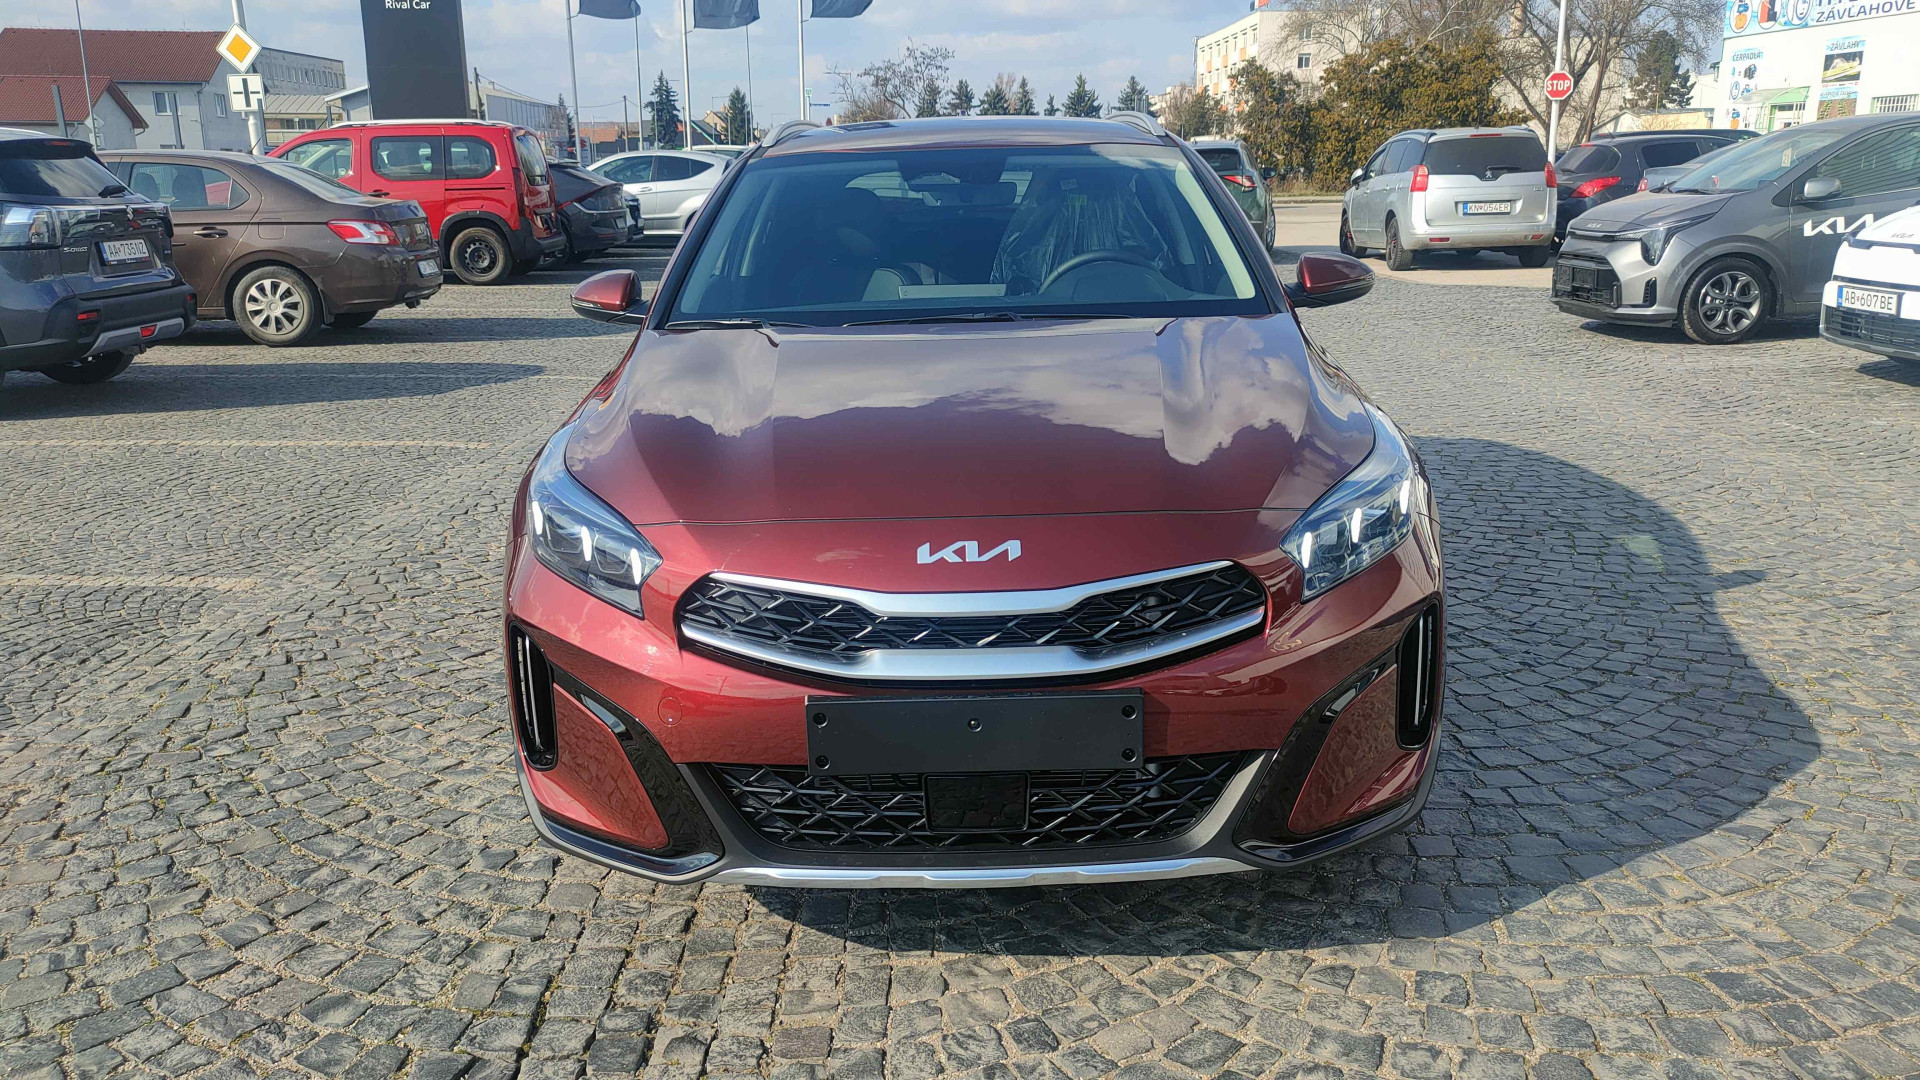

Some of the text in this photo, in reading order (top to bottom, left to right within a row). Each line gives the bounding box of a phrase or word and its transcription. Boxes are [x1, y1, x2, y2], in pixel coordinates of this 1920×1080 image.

[385, 0, 431, 9] Rival Car
[1547, 80, 1570, 91] STOP
[917, 540, 1022, 564] KIA
